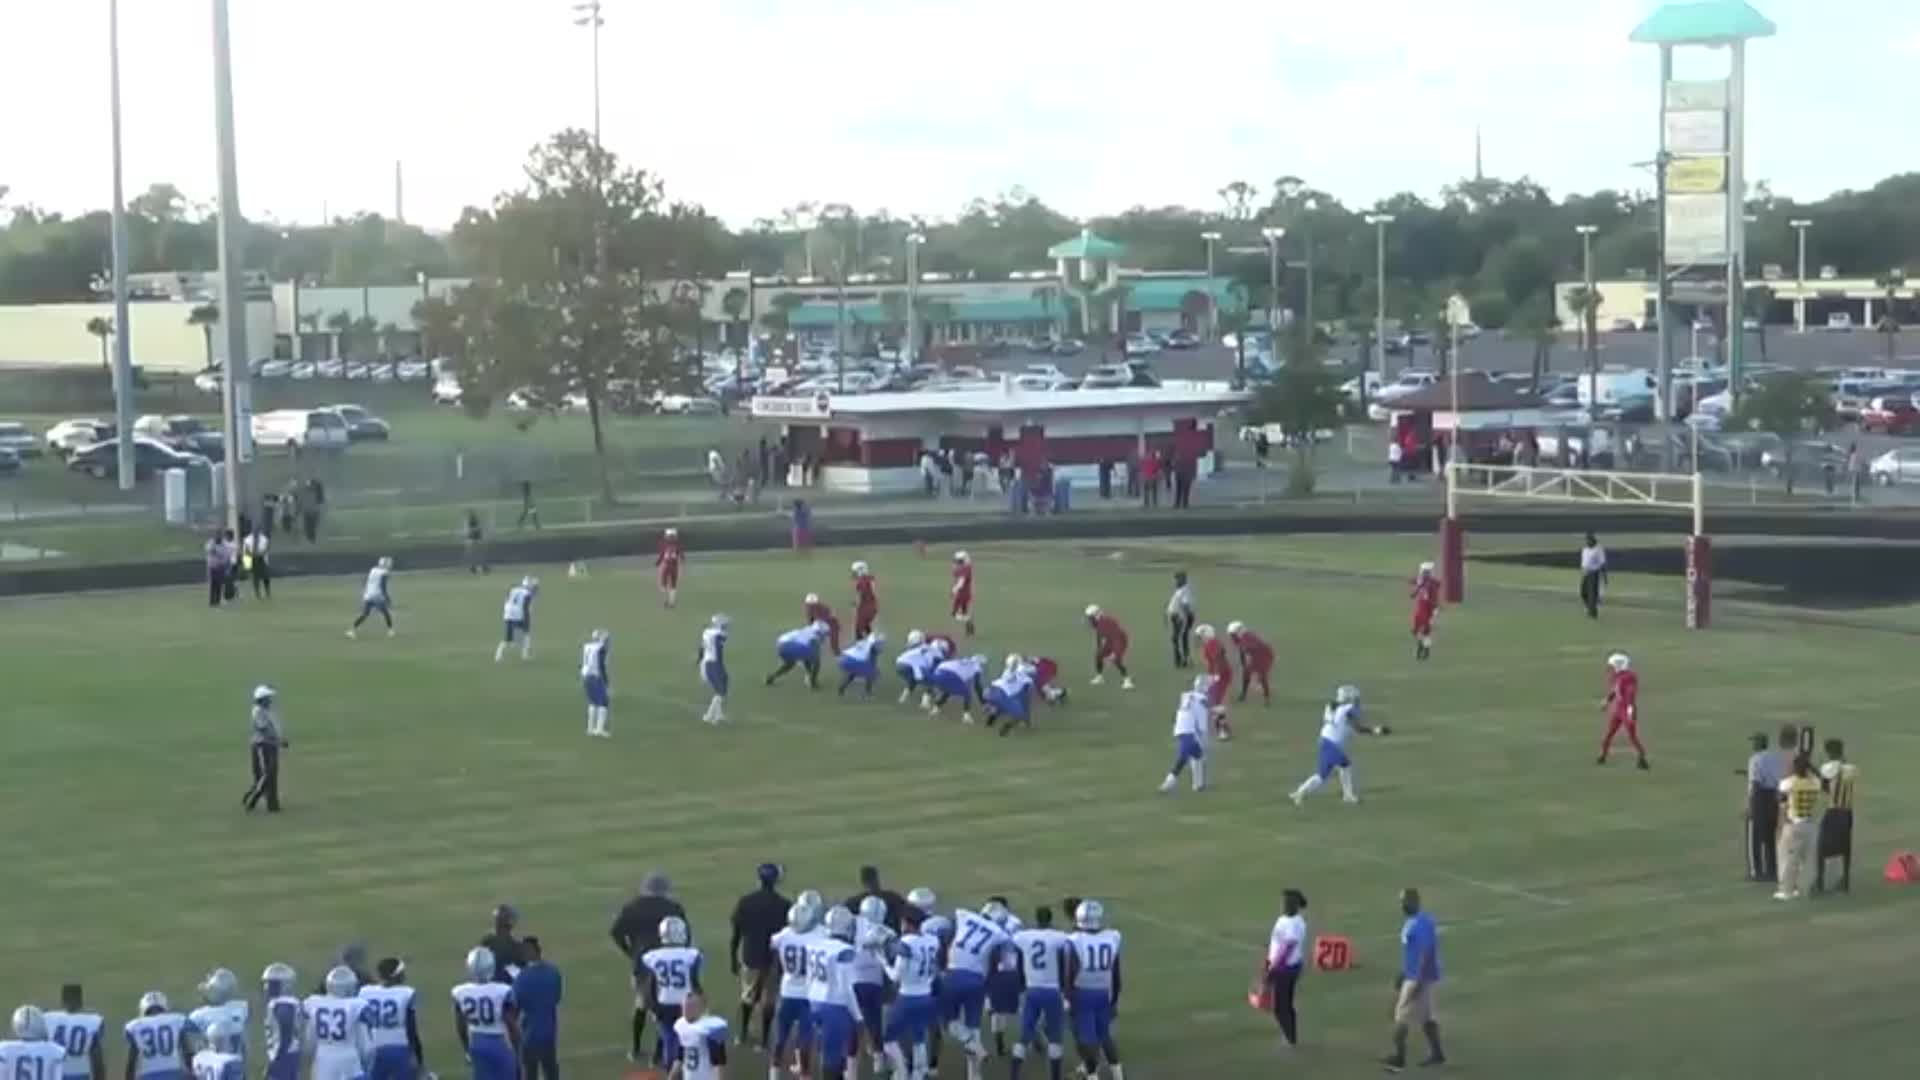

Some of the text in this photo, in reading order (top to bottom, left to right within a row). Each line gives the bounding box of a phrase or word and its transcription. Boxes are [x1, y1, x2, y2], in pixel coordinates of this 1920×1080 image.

[956, 919, 993, 955] 77
[1031, 939, 1047, 970] 2
[1086, 942, 1112, 972] 10
[1316, 940, 1348, 970] 20
[655, 959, 687, 989] 35
[315, 1007, 347, 1041] 63
[463, 996, 495, 1025] 20
[53, 1024, 87, 1057] 40
[140, 1024, 174, 1058] 30
[15, 1055, 44, 1080] 61
